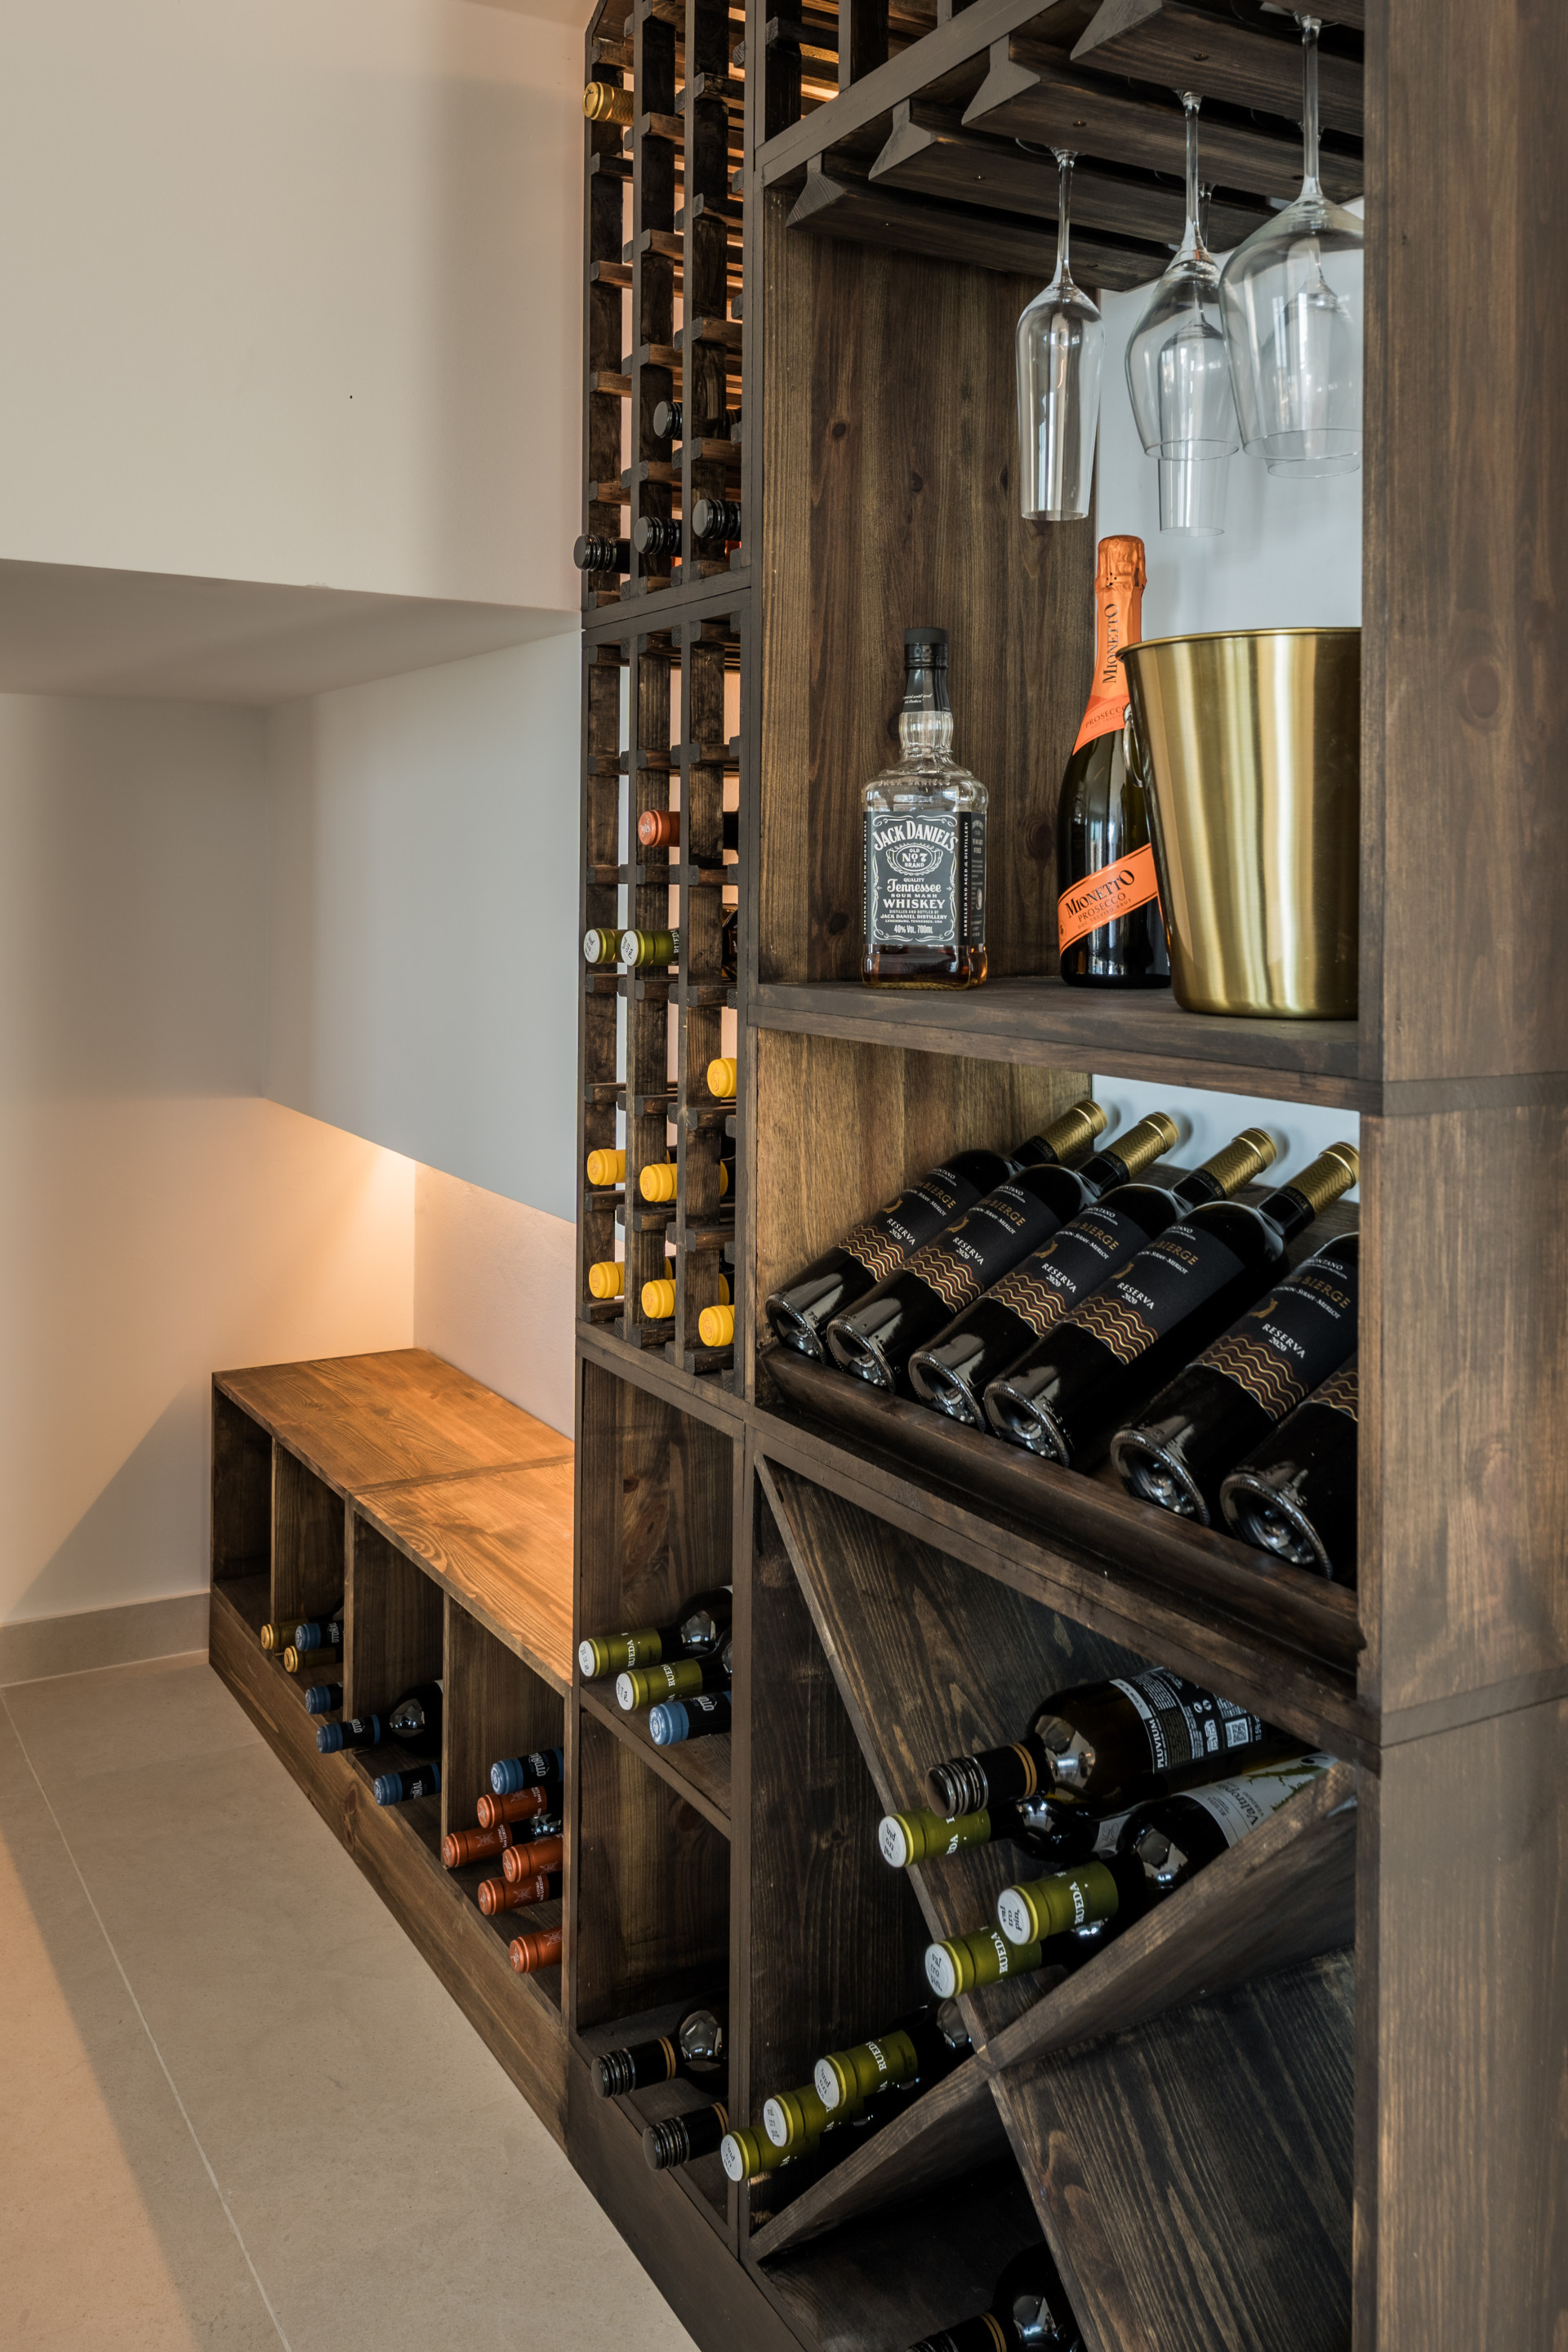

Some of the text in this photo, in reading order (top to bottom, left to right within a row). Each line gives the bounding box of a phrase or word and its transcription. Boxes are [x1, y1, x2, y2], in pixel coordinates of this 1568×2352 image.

[1102, 604, 1119, 684] MIONETTO
[872, 825, 906, 850] JACK
[906, 820, 959, 853] DANIEL'S
[920, 853, 928, 862] 7
[887, 879, 942, 893] Tennessee
[1065, 870, 1134, 919] MIONETTO
[883, 899, 946, 909] WHISKEY
[1078, 893, 1125, 923] PROSECCO
[894, 924, 906, 933] 40%
[923, 1180, 956, 1209] BIERGE
[990, 1200, 1026, 1227] BIERGE
[887, 1218, 915, 1245] RESERVA
[889, 1228, 902, 1240] 2020
[1080, 1223, 1120, 1250] BIERGE
[953, 1237, 984, 1265] RESERVA
[956, 1248, 969, 1259] 2020
[1157, 1241, 1199, 1265] BIERGE
[1041, 1263, 1076, 1293] RESERVA
[1046, 1275, 1062, 1287] 2020
[1117, 1282, 1155, 1310] RESERVA
[1121, 1293, 1138, 1304] 2020
[1302, 1276, 1351, 1308] BIERGE
[1262, 1323, 1306, 1359] RESERVA
[1268, 1336, 1287, 1352] 2020
[1148, 1718, 1165, 1769] PLUVIUM
[1069, 1881, 1085, 1925] RUEDA
[932, 1953, 942, 1968] val
[991, 1931, 1009, 1975] RUEDA
[931, 1965, 939, 1977] tro
